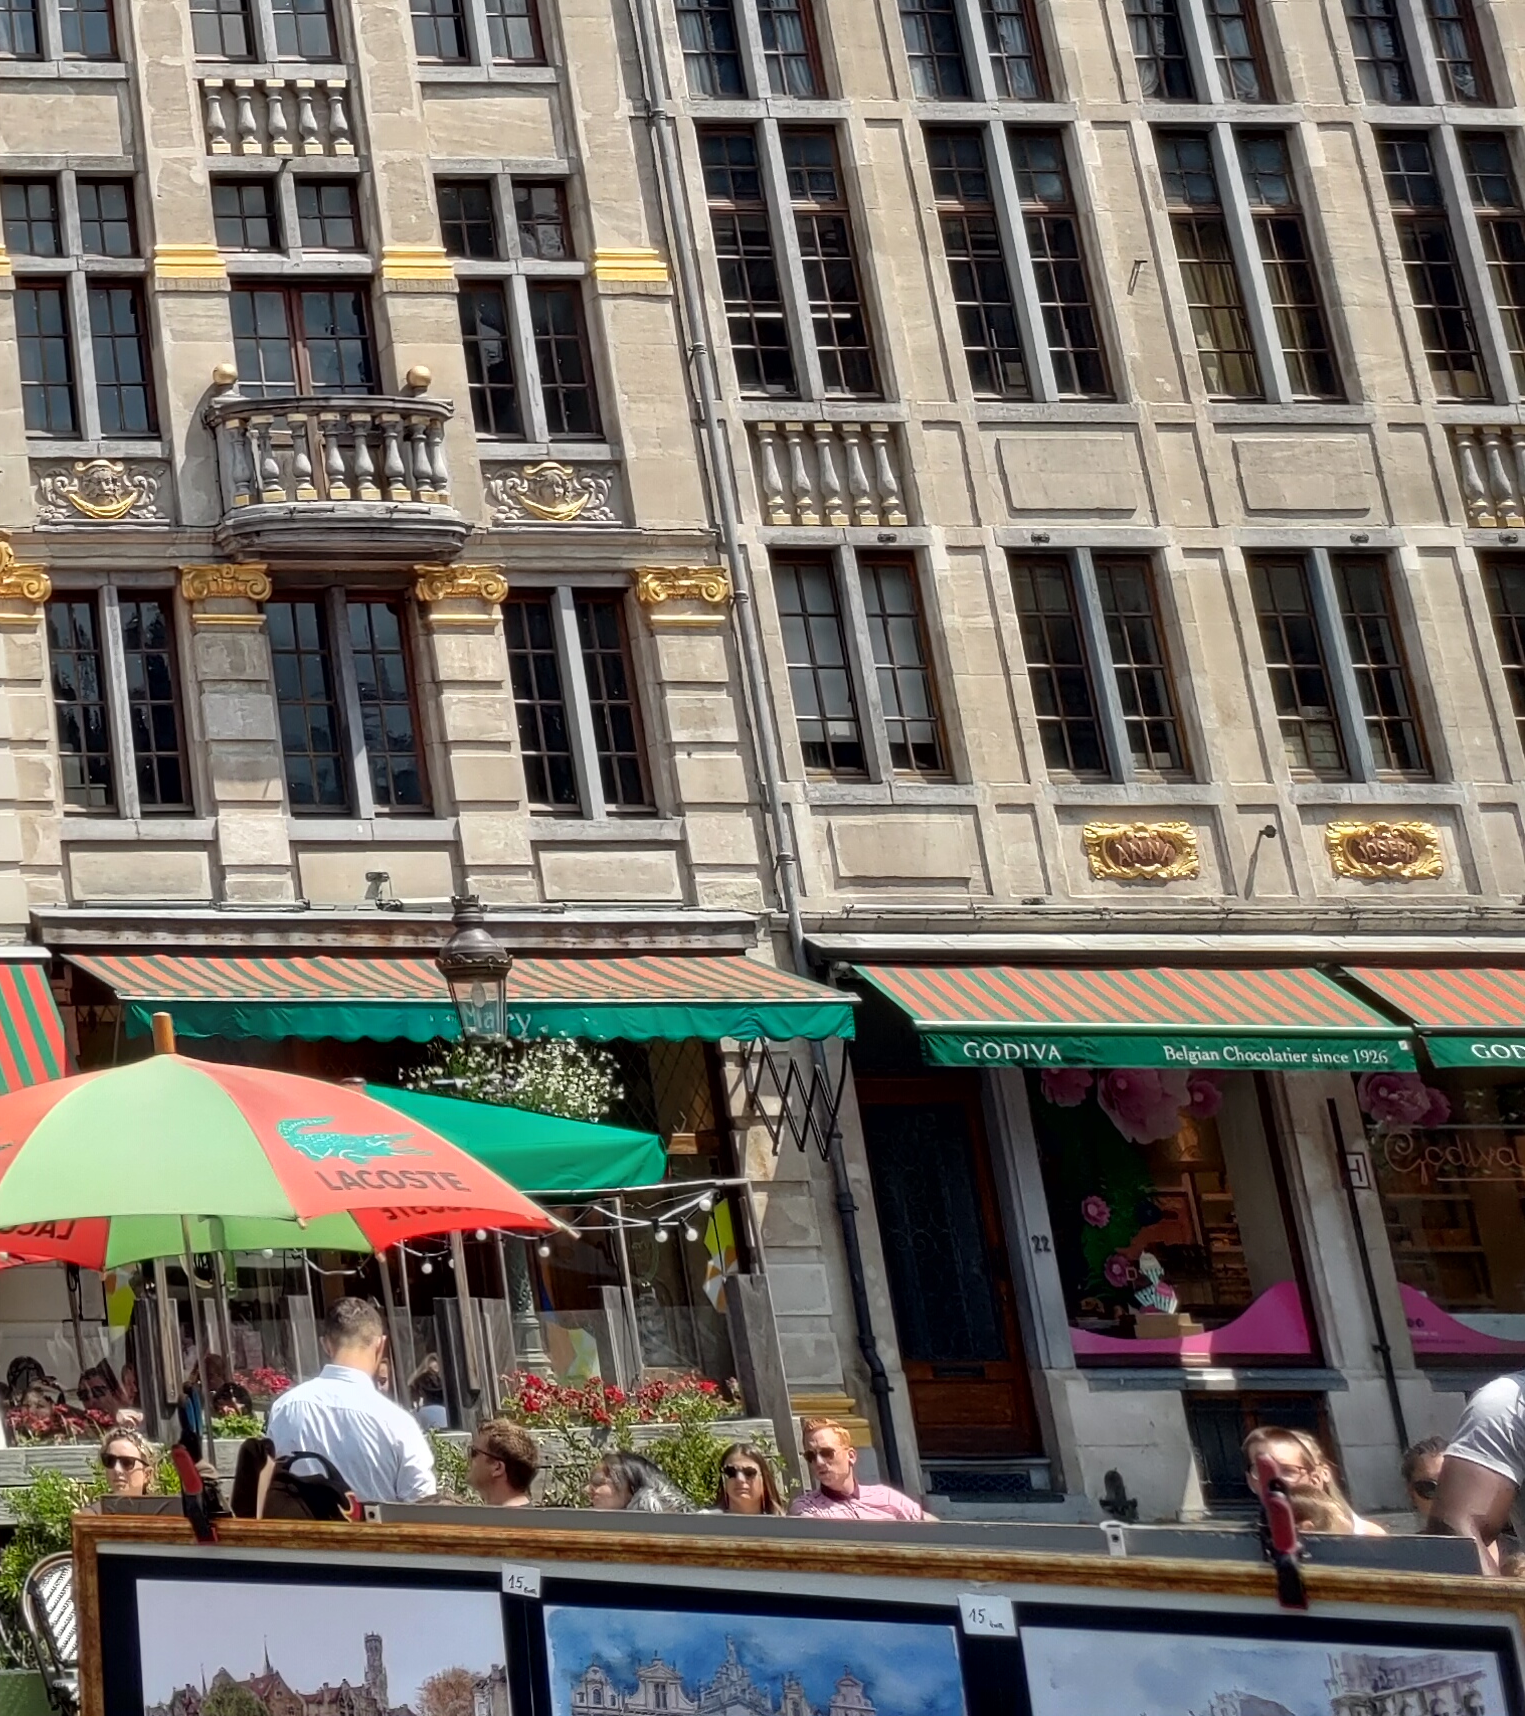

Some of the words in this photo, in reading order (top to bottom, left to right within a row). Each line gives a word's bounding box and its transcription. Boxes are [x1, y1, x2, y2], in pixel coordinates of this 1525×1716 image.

[1115, 841, 1173, 865] ANNA
[1358, 840, 1419, 863] JOSEPH
[963, 1041, 1062, 1061] GODIVA
[1163, 1045, 1220, 1064] Belgian
[1223, 1045, 1307, 1062] Chocolatier
[1312, 1048, 1349, 1063] since
[1353, 1049, 1388, 1064] 1926
[1385, 1131, 1525, 1184] Godiva
[315, 1170, 471, 1193] LACOSTE
[1031, 1235, 1051, 1253] 22
[509, 1575, 525, 1589] 15
[969, 1608, 986, 1624] 15
